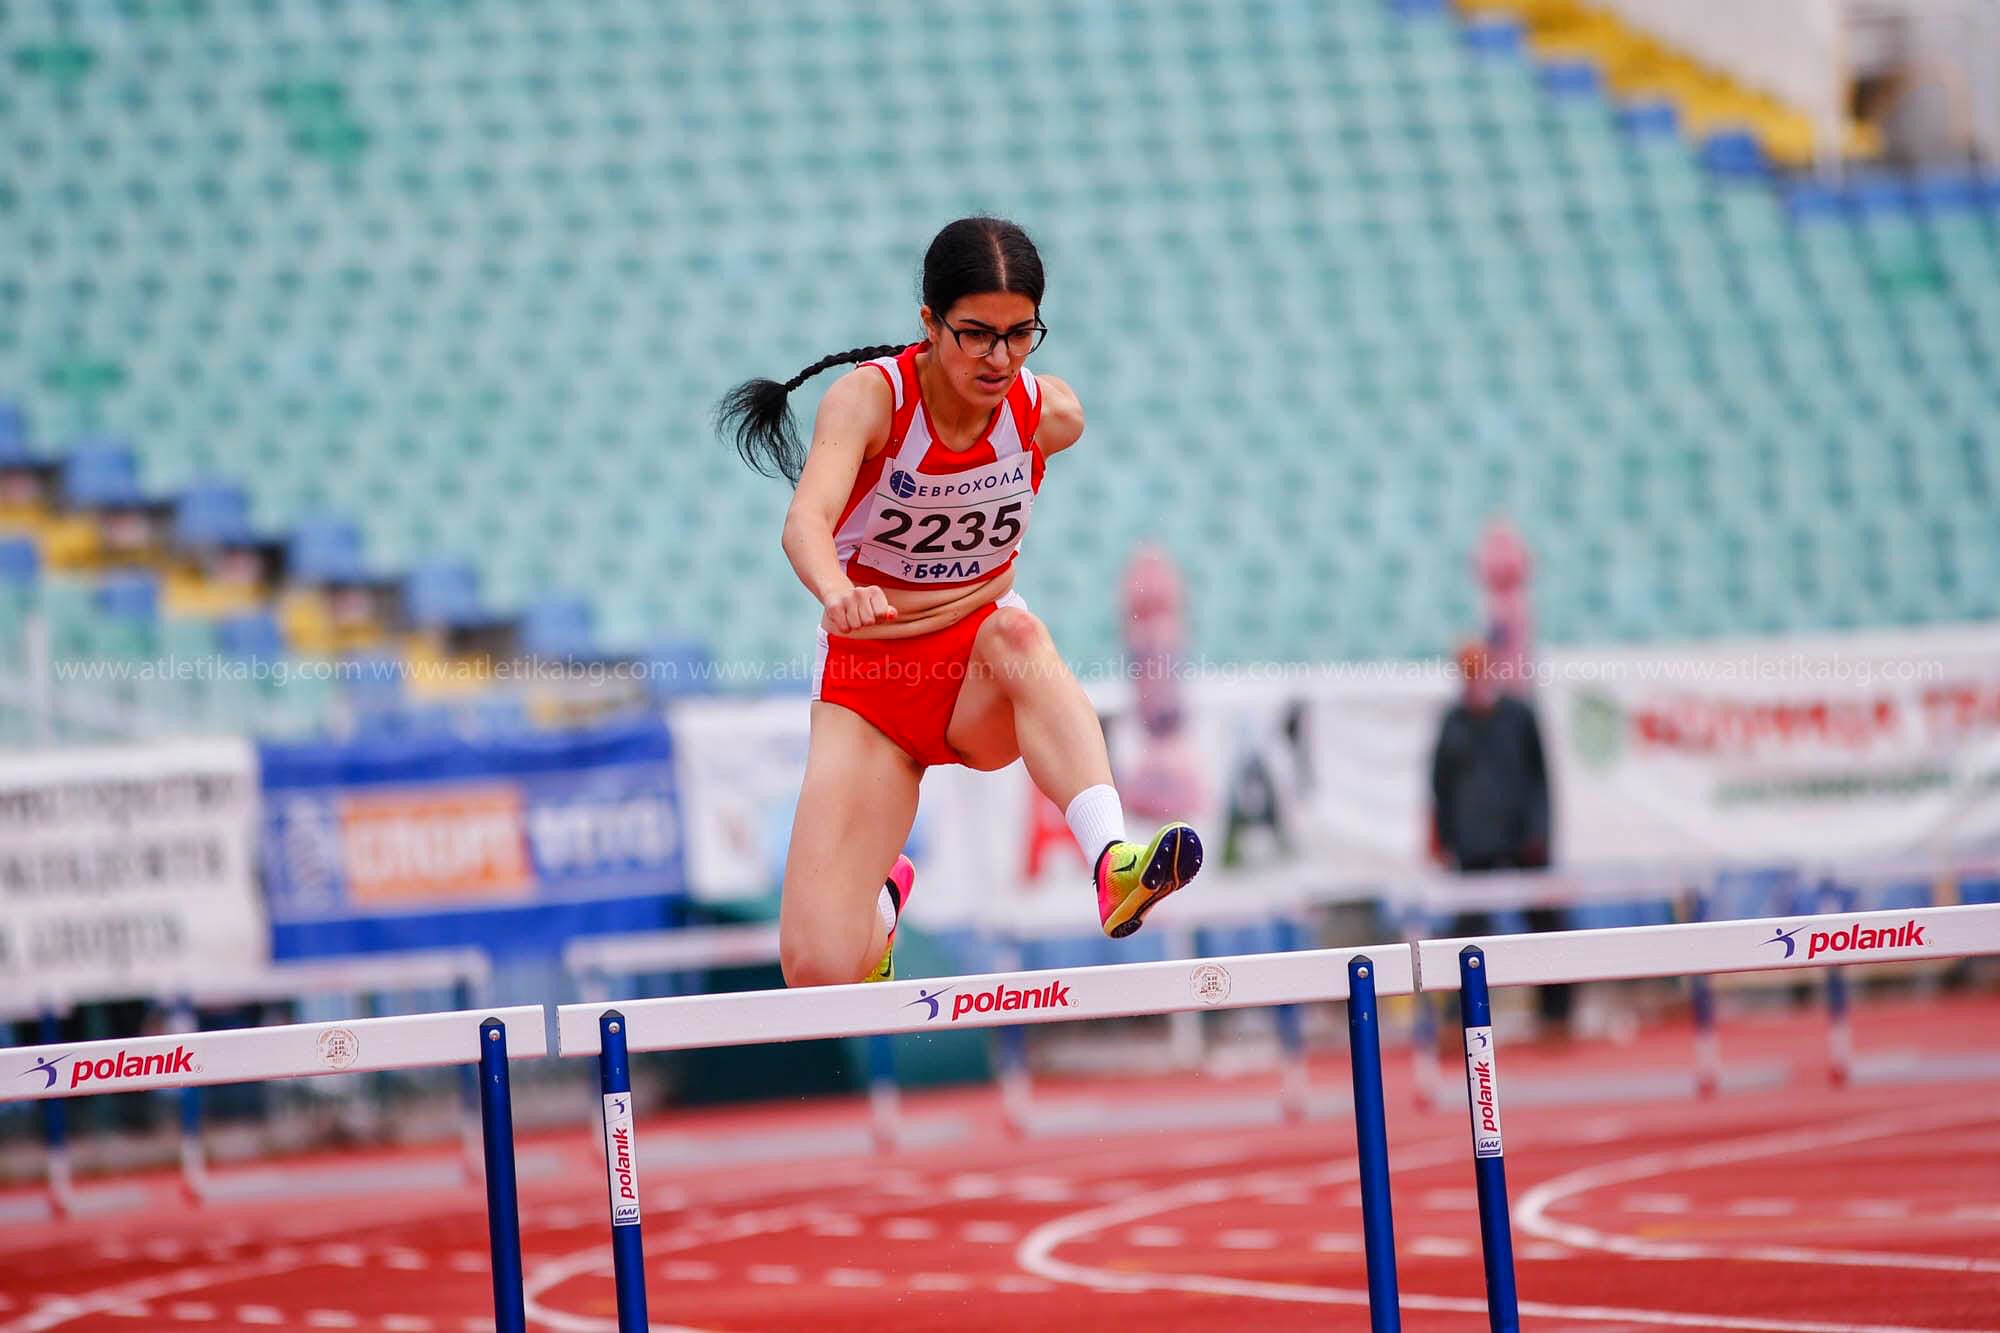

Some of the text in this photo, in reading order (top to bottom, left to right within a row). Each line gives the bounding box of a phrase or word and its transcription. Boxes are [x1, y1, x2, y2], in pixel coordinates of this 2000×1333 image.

[873, 502, 1022, 554] 2235
[914, 561, 980, 579] БФЛА
[1808, 919, 1926, 959] polanik
[952, 980, 1071, 1021] polanik
[71, 1045, 194, 1088] polanik
[1474, 1061, 1497, 1132] polanik
[612, 1127, 635, 1199] polanik
[1480, 1140, 1499, 1149] IAAF
[617, 1207, 638, 1217] IAAF
